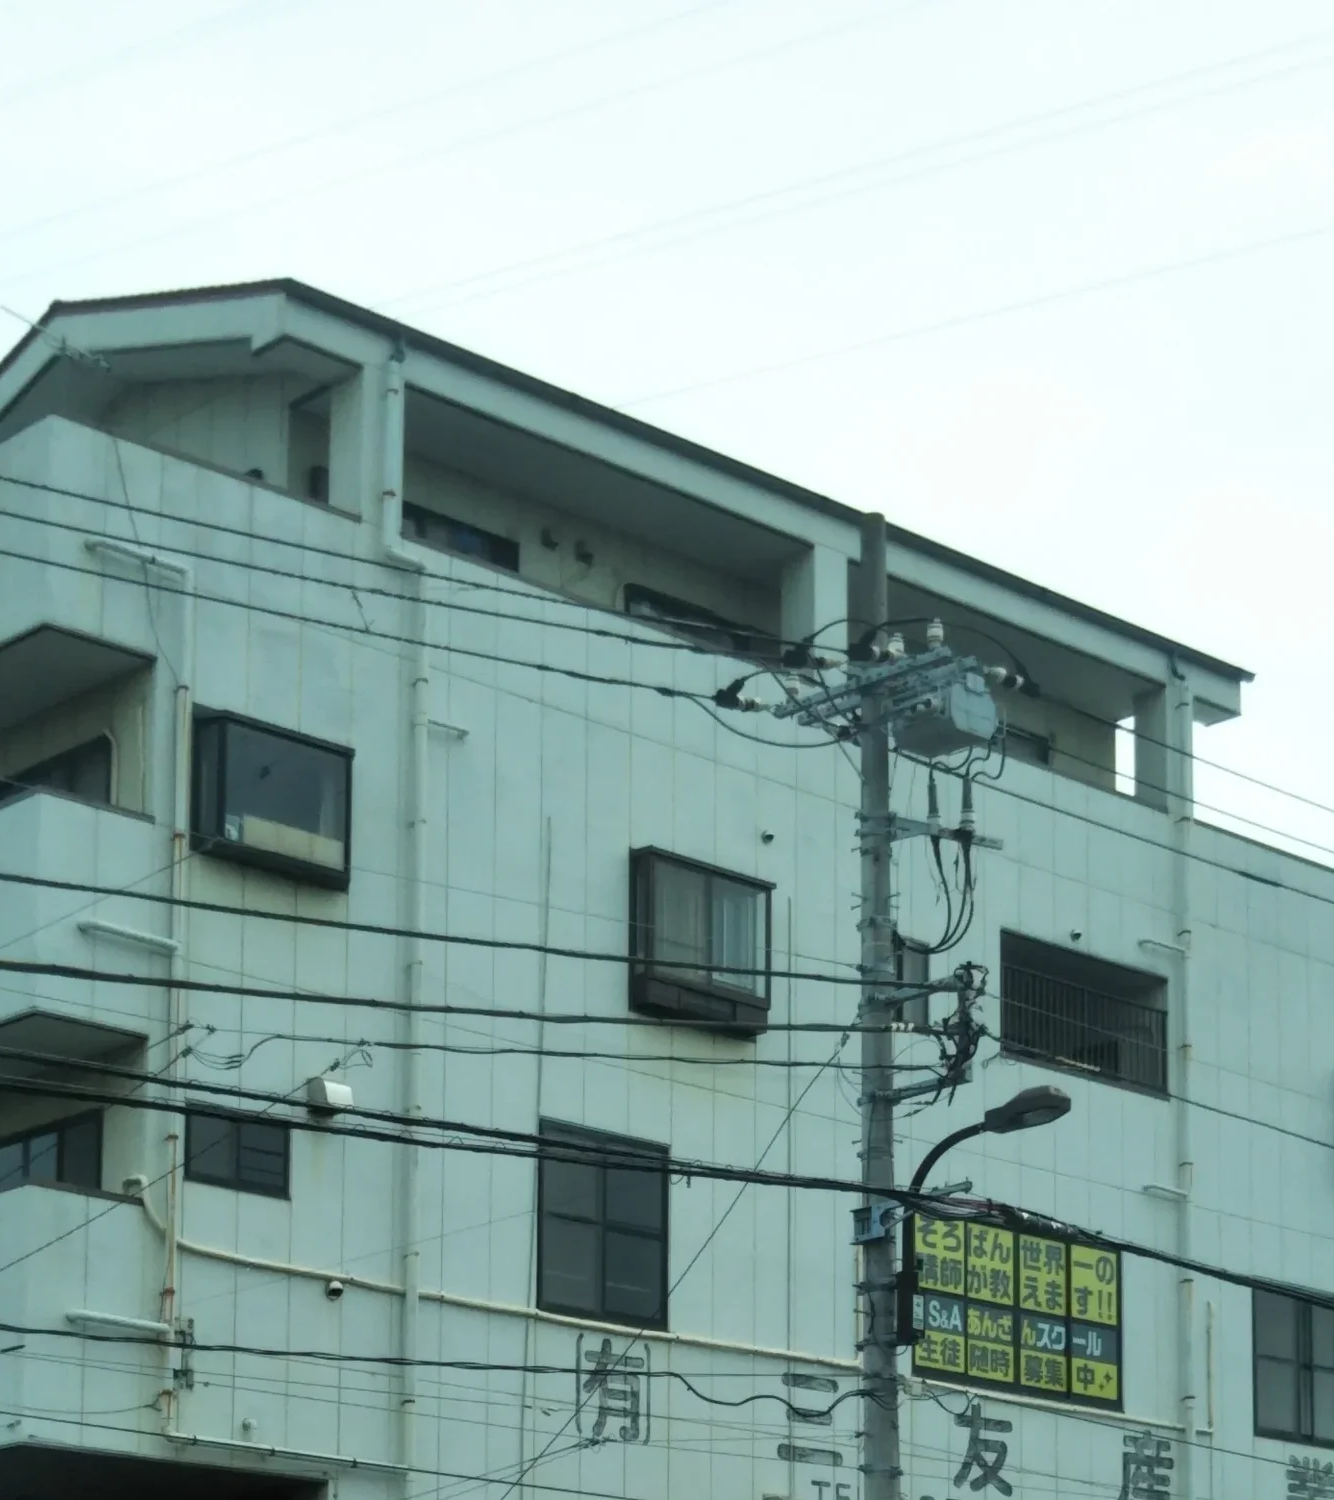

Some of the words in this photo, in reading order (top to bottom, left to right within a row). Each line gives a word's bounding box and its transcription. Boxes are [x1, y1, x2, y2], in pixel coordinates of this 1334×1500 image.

[918, 1215, 1115, 1285] そろばん世界一の
[928, 1300, 963, 1332] S&A
[968, 1307, 1103, 1356] あんざんスクール
[918, 1334, 1095, 1391] 生徒随時募集中
